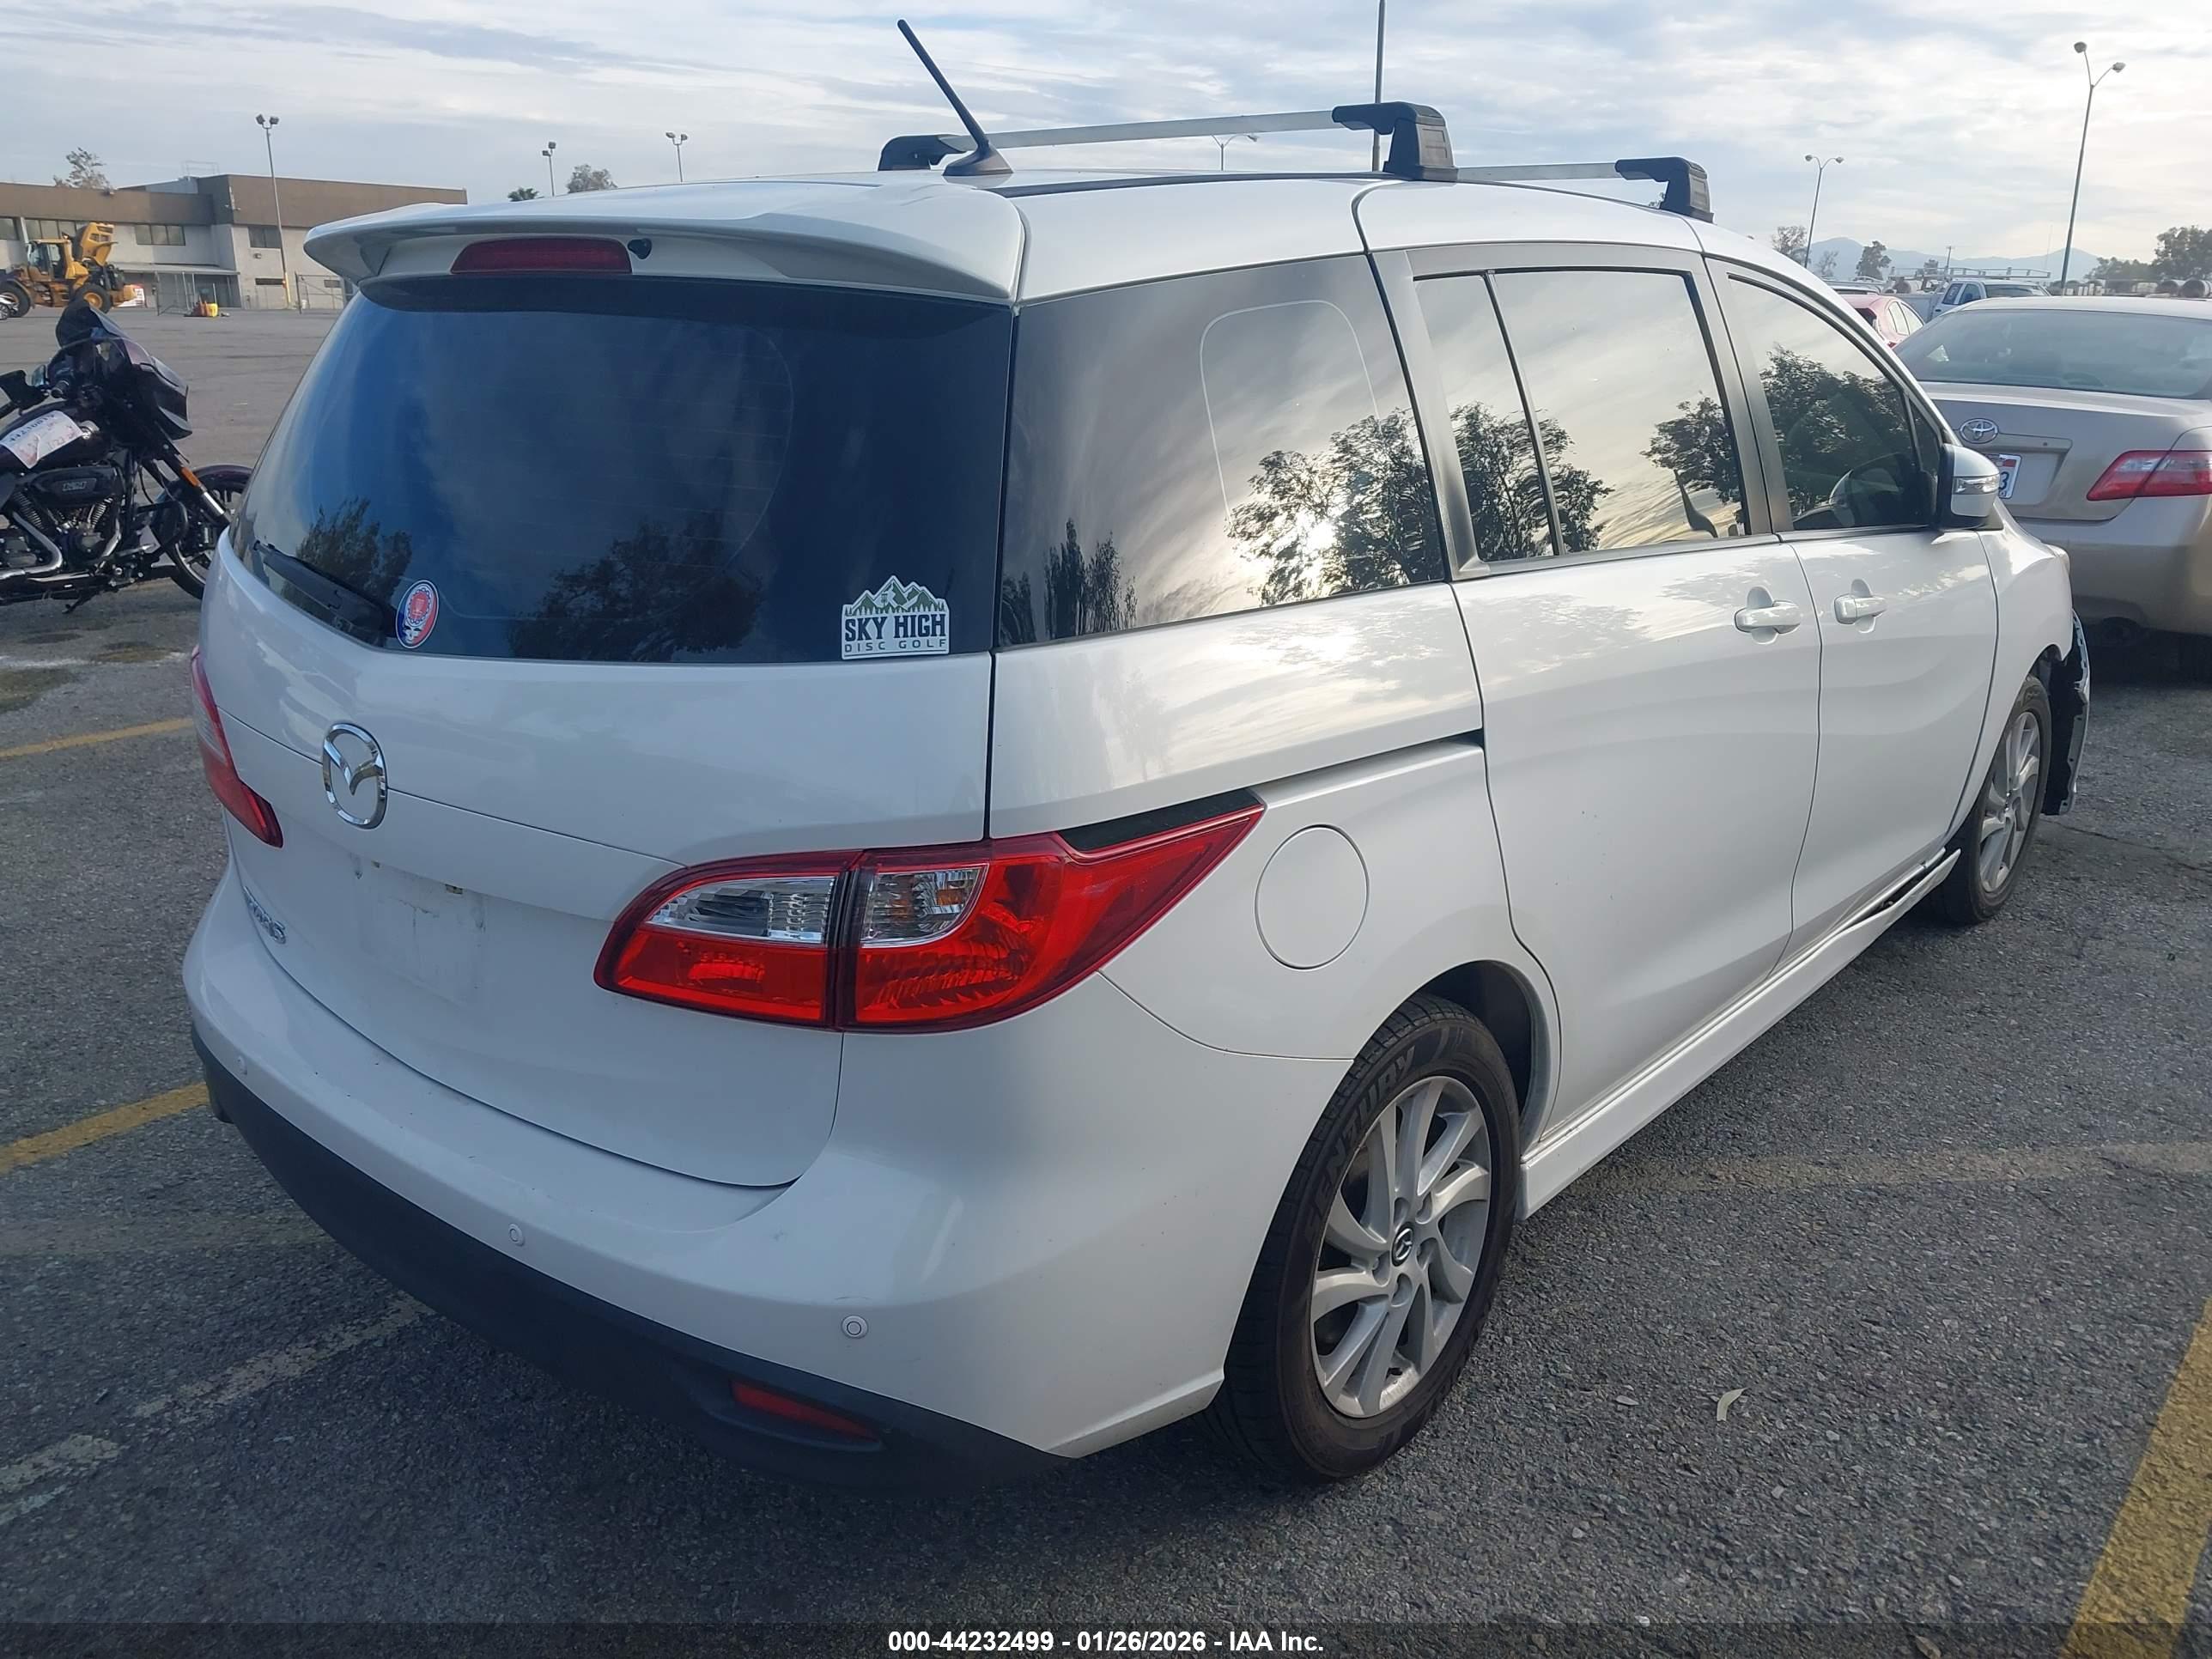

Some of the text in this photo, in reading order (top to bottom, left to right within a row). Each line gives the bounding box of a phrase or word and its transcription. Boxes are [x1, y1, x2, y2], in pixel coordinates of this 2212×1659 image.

[845, 613, 947, 642] SKY HIGH
[845, 638, 947, 653] DISC GOLF
